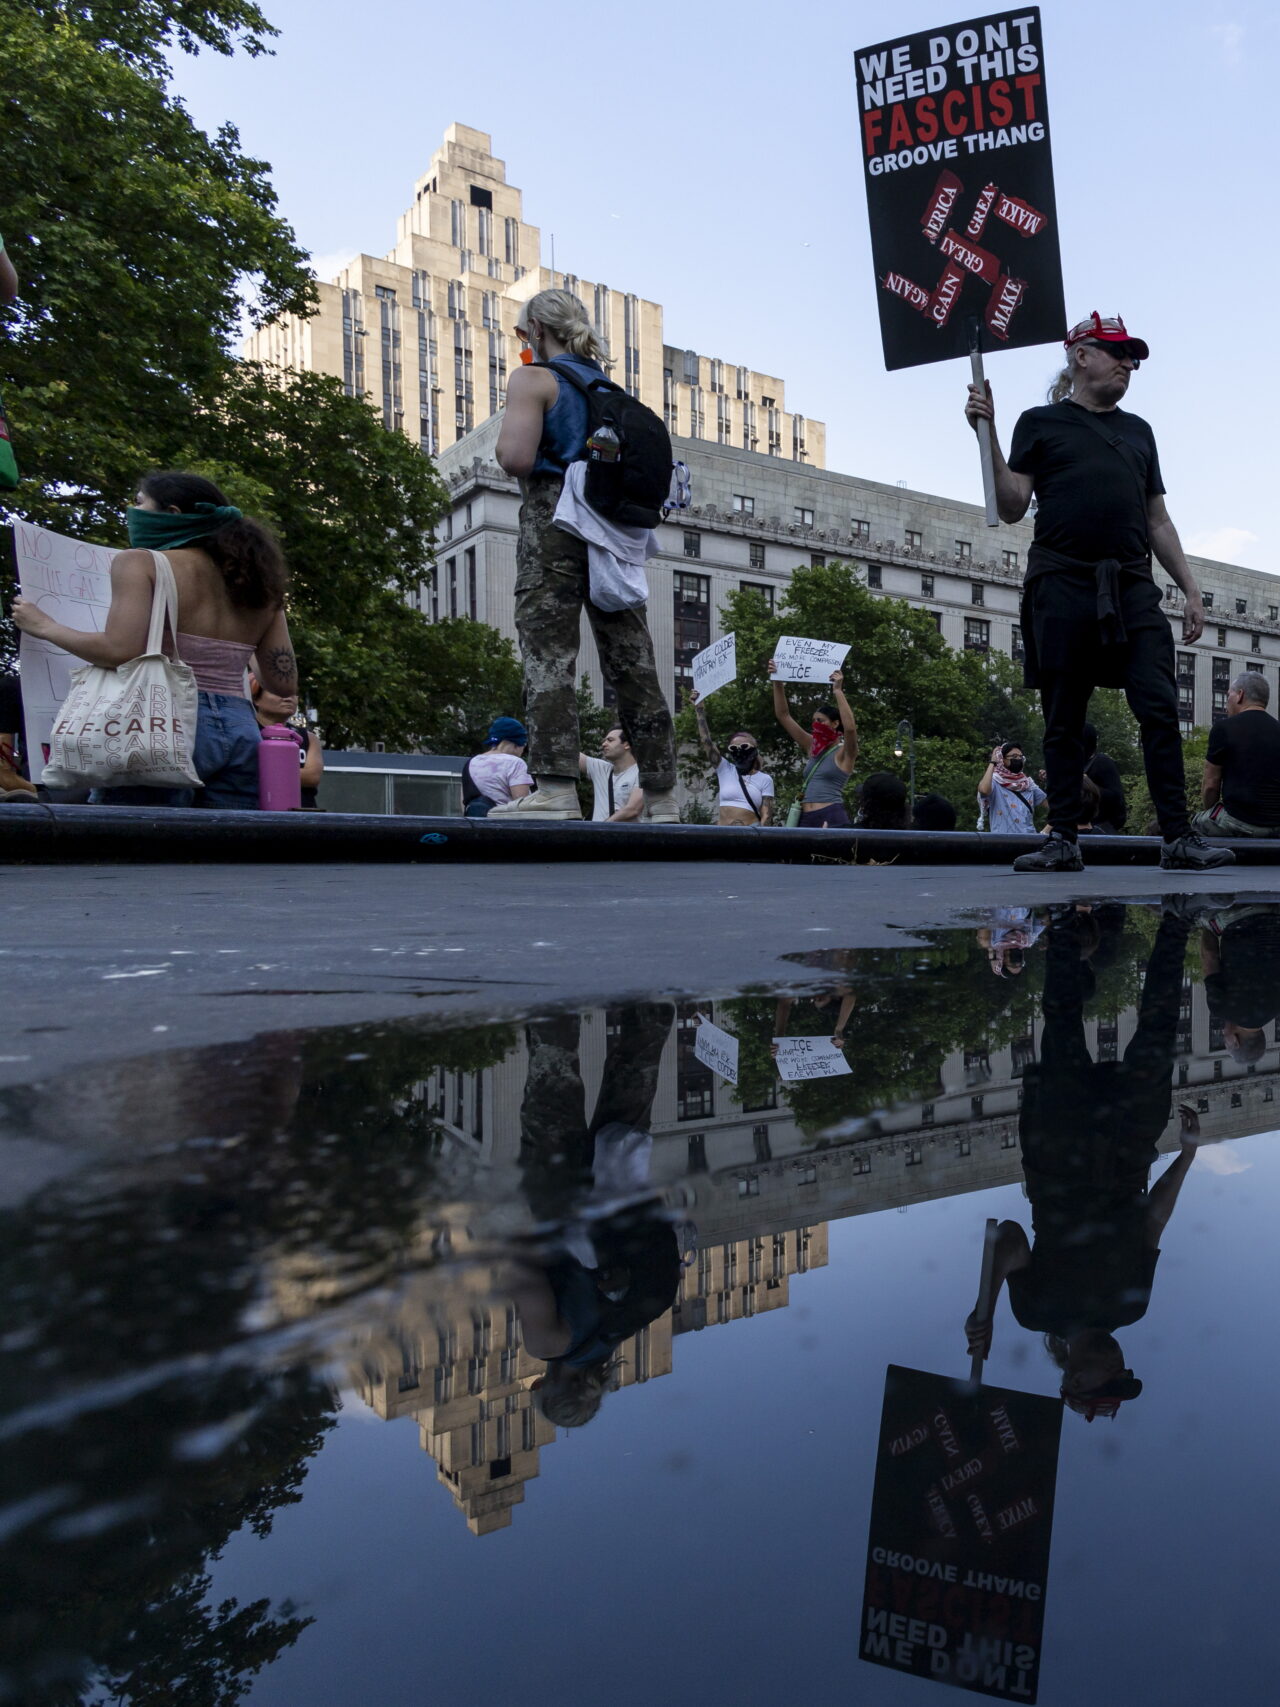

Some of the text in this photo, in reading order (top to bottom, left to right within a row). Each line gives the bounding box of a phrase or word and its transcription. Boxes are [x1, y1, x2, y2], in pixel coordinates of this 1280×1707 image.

[860, 16, 1034, 82] WE DONT
[863, 44, 1038, 110] NEED THIS
[863, 74, 1040, 156] FASCIST
[869, 122, 1044, 175] GROOVE THANG
[999, 199, 1041, 234] MAKE
[991, 279, 1021, 331] MAKE
[20, 527, 52, 560] NO
[788, 666, 811, 678] ICE
[794, 647, 829, 656] FREEZER
